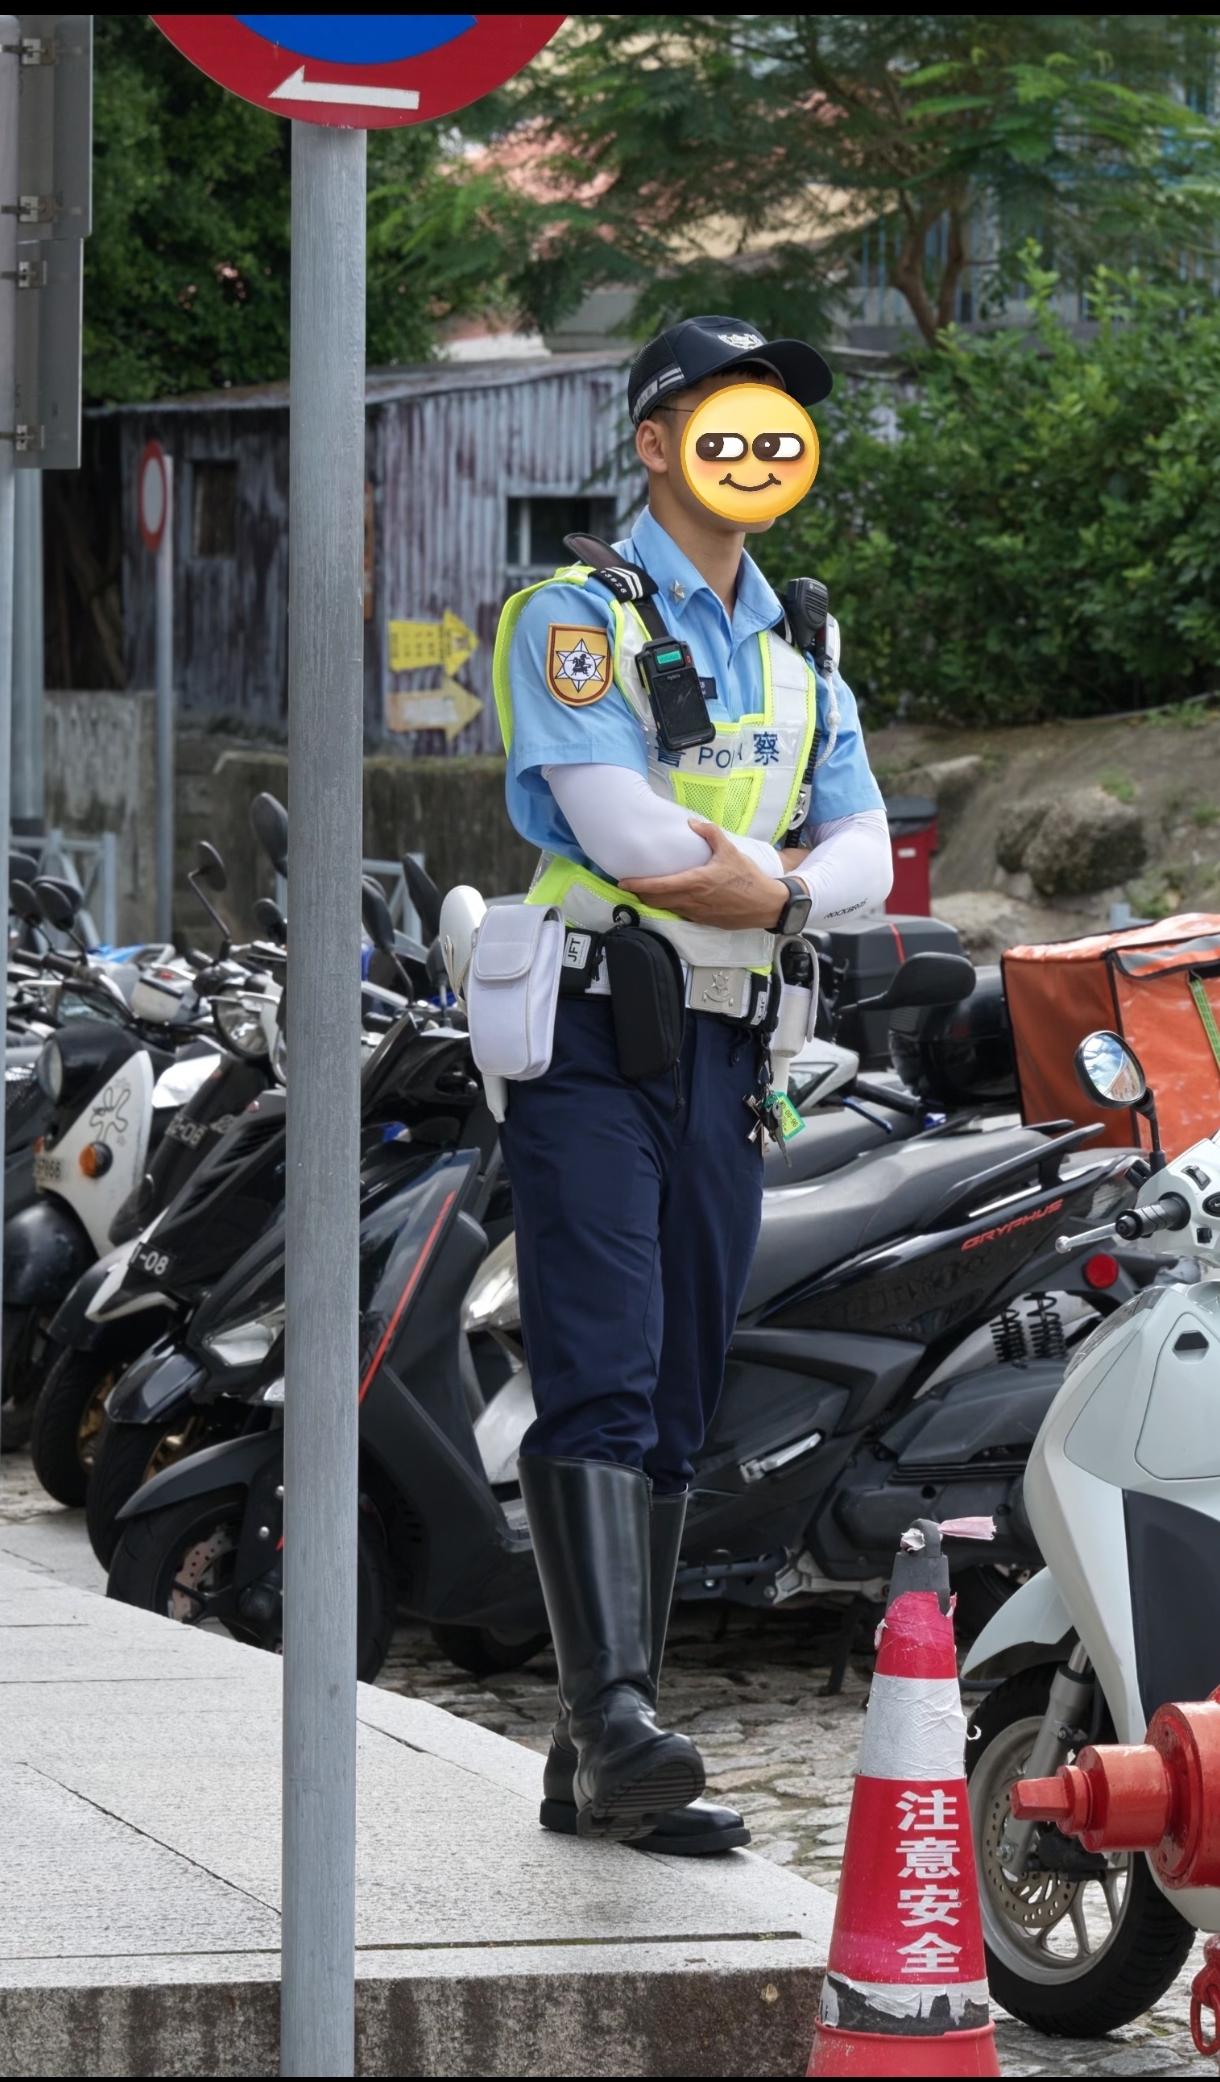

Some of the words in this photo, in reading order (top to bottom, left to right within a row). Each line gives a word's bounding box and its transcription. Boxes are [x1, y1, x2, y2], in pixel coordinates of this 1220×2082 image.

[753, 732, 780, 766] 察
[567, 937, 581, 962] JFT
[961, 1199, 1064, 1252] GRYPHUS
[896, 1789, 962, 1974] 注意安全
